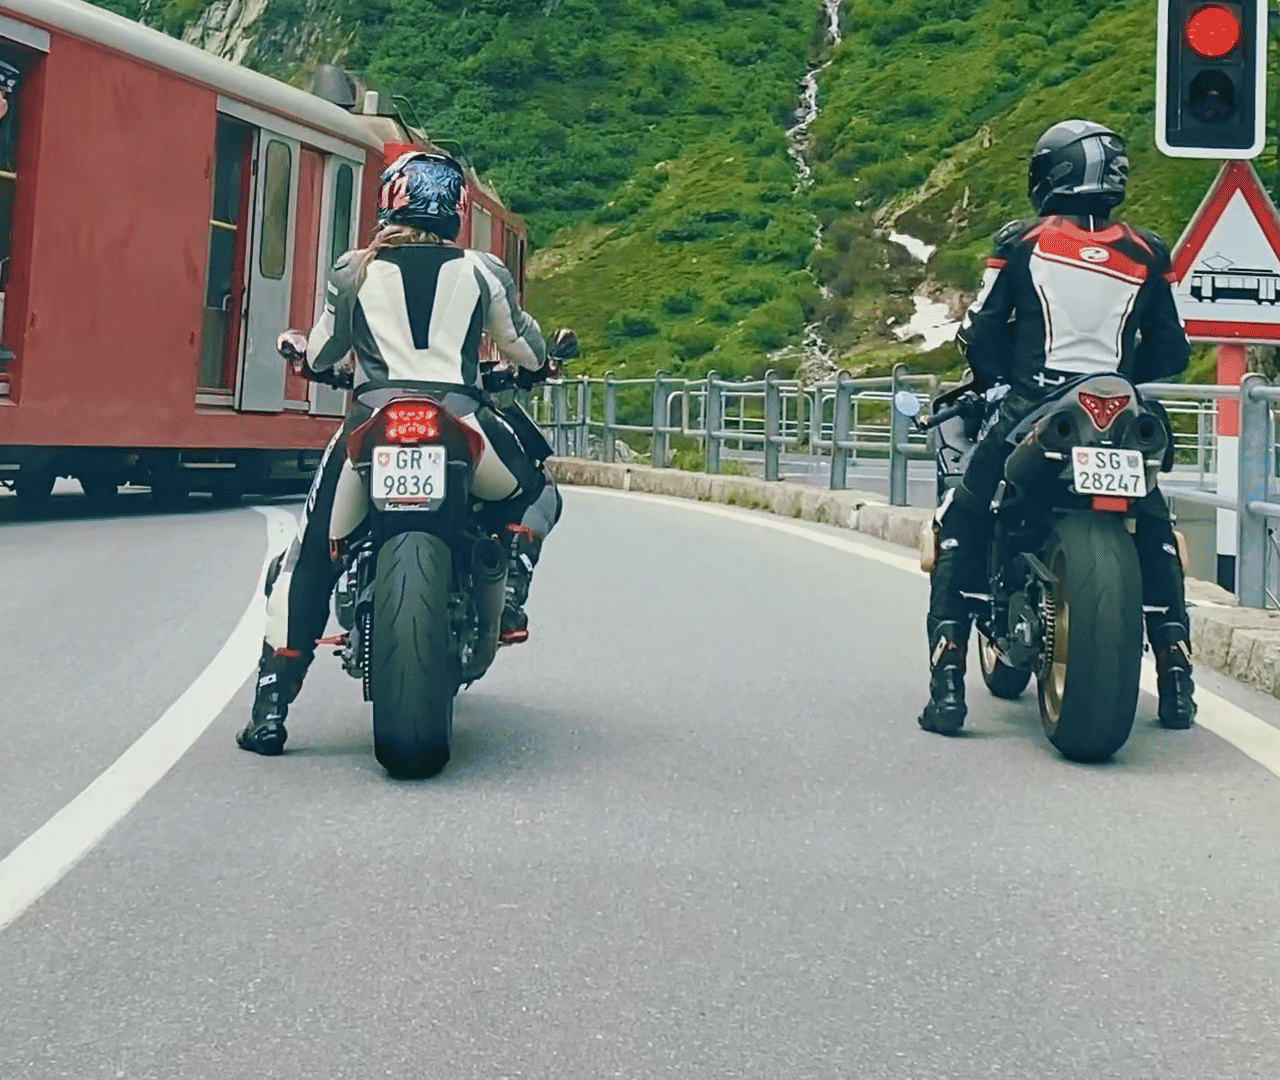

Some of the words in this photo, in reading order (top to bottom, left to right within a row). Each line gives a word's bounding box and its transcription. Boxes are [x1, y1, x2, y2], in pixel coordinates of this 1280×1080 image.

[396, 449, 422, 470] GR
[1095, 451, 1121, 469] SG
[383, 475, 434, 496] 9836
[1079, 471, 1140, 493] 28247
